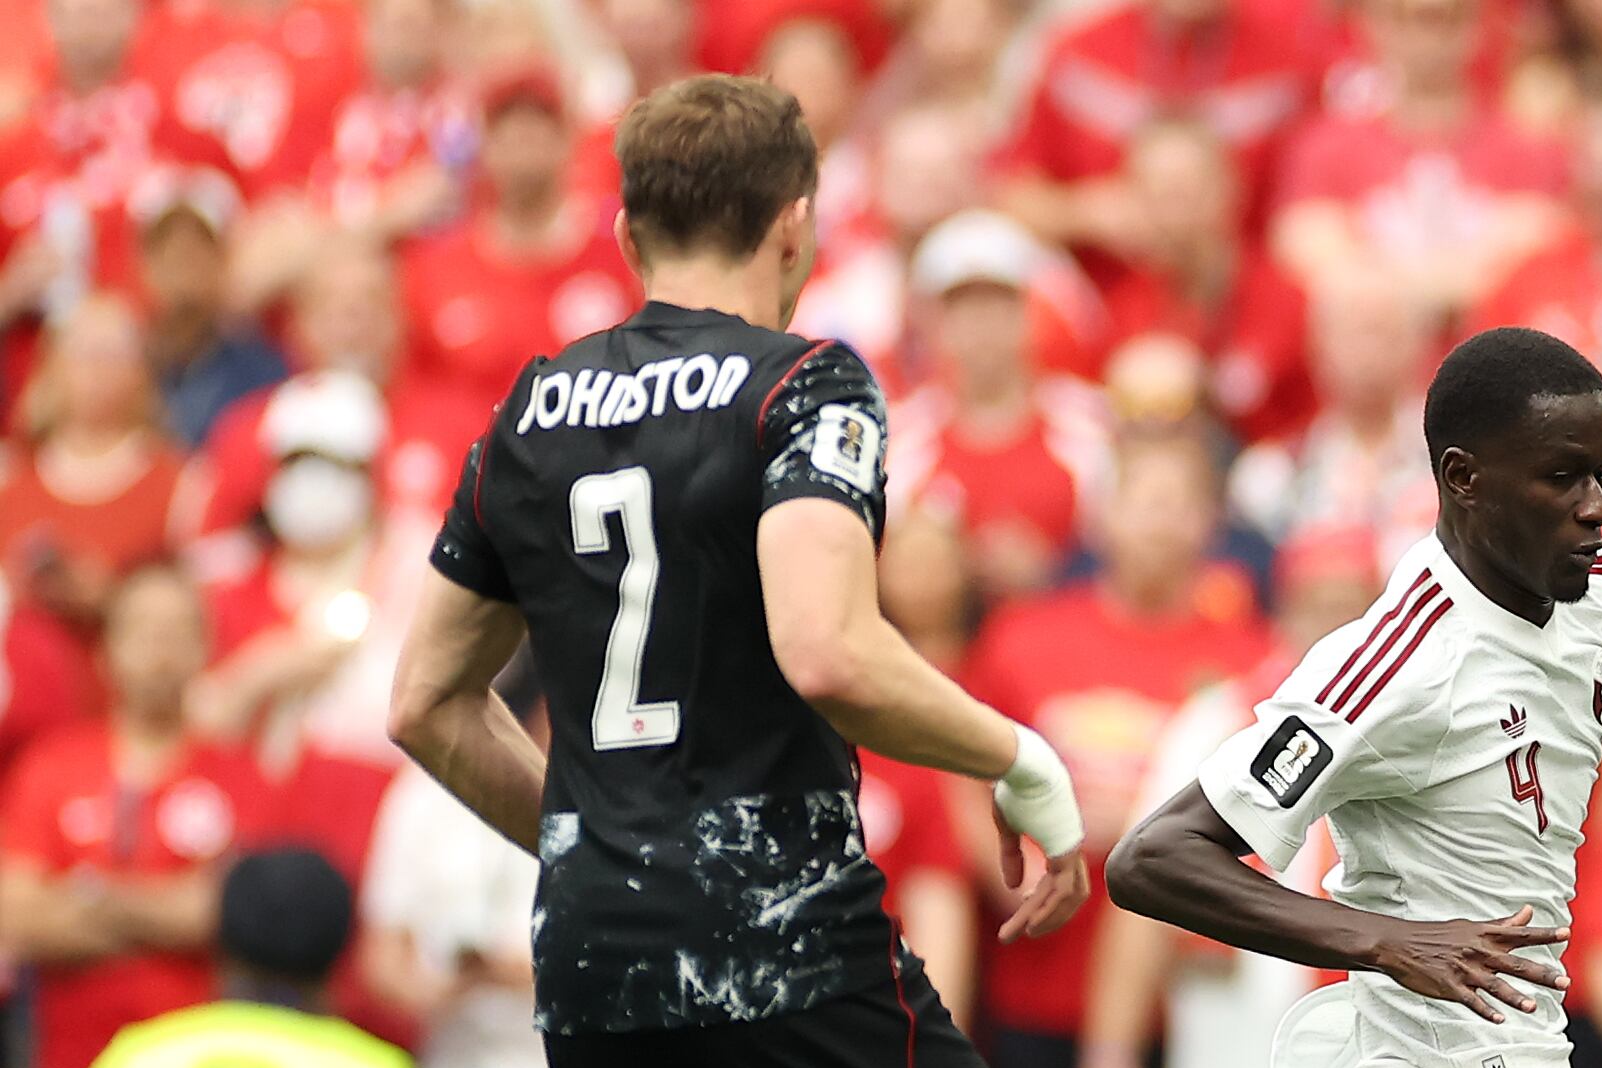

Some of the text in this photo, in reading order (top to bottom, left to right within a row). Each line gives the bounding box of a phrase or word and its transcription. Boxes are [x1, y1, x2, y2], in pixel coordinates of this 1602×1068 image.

[516, 353, 751, 436] JOHNSTON
[569, 465, 681, 751] 2
[1505, 741, 1544, 838] 4
